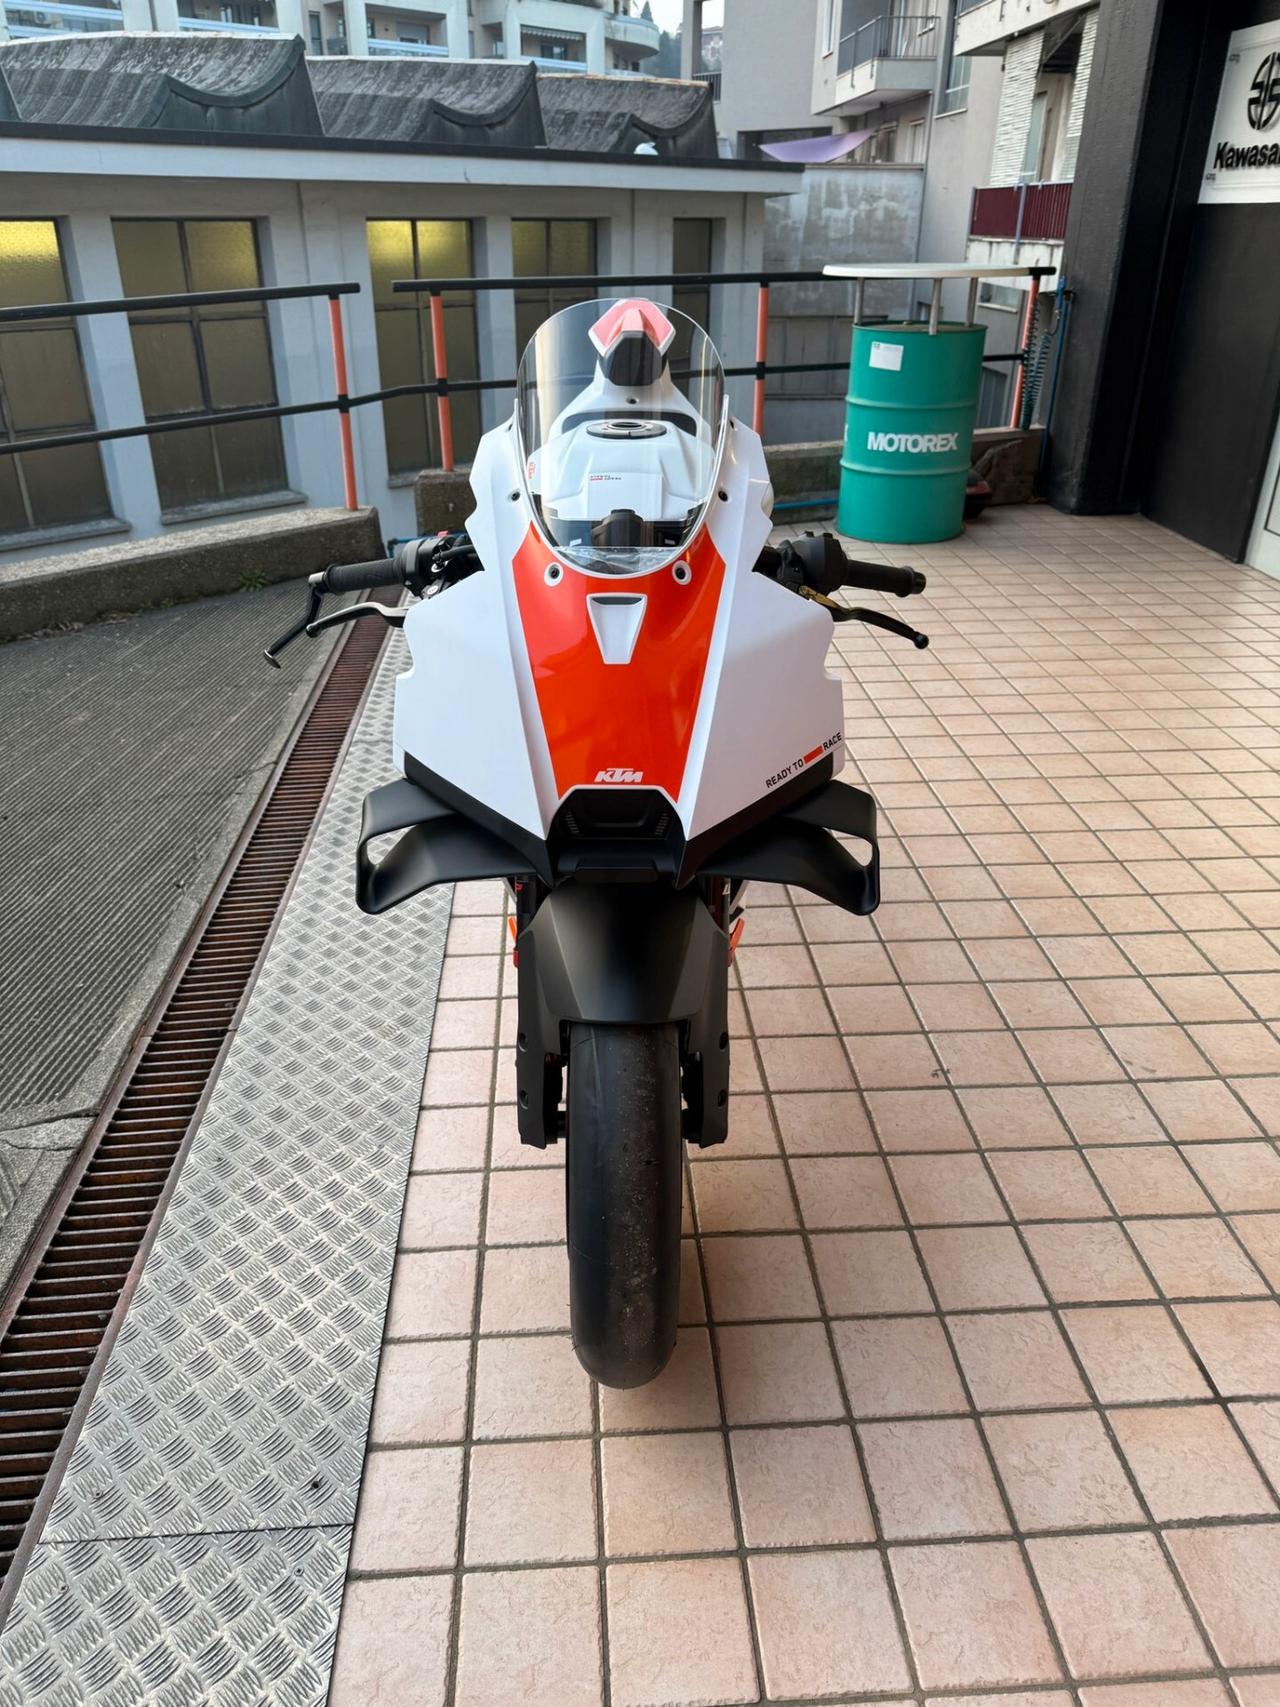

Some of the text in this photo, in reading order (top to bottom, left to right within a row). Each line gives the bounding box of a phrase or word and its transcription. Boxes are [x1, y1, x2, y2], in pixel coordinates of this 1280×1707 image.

[1213, 141, 1280, 169] Kawasa
[867, 431, 959, 453] MOTOREX
[765, 732, 842, 788] READY TO RACE
[594, 768, 644, 783] KTM
